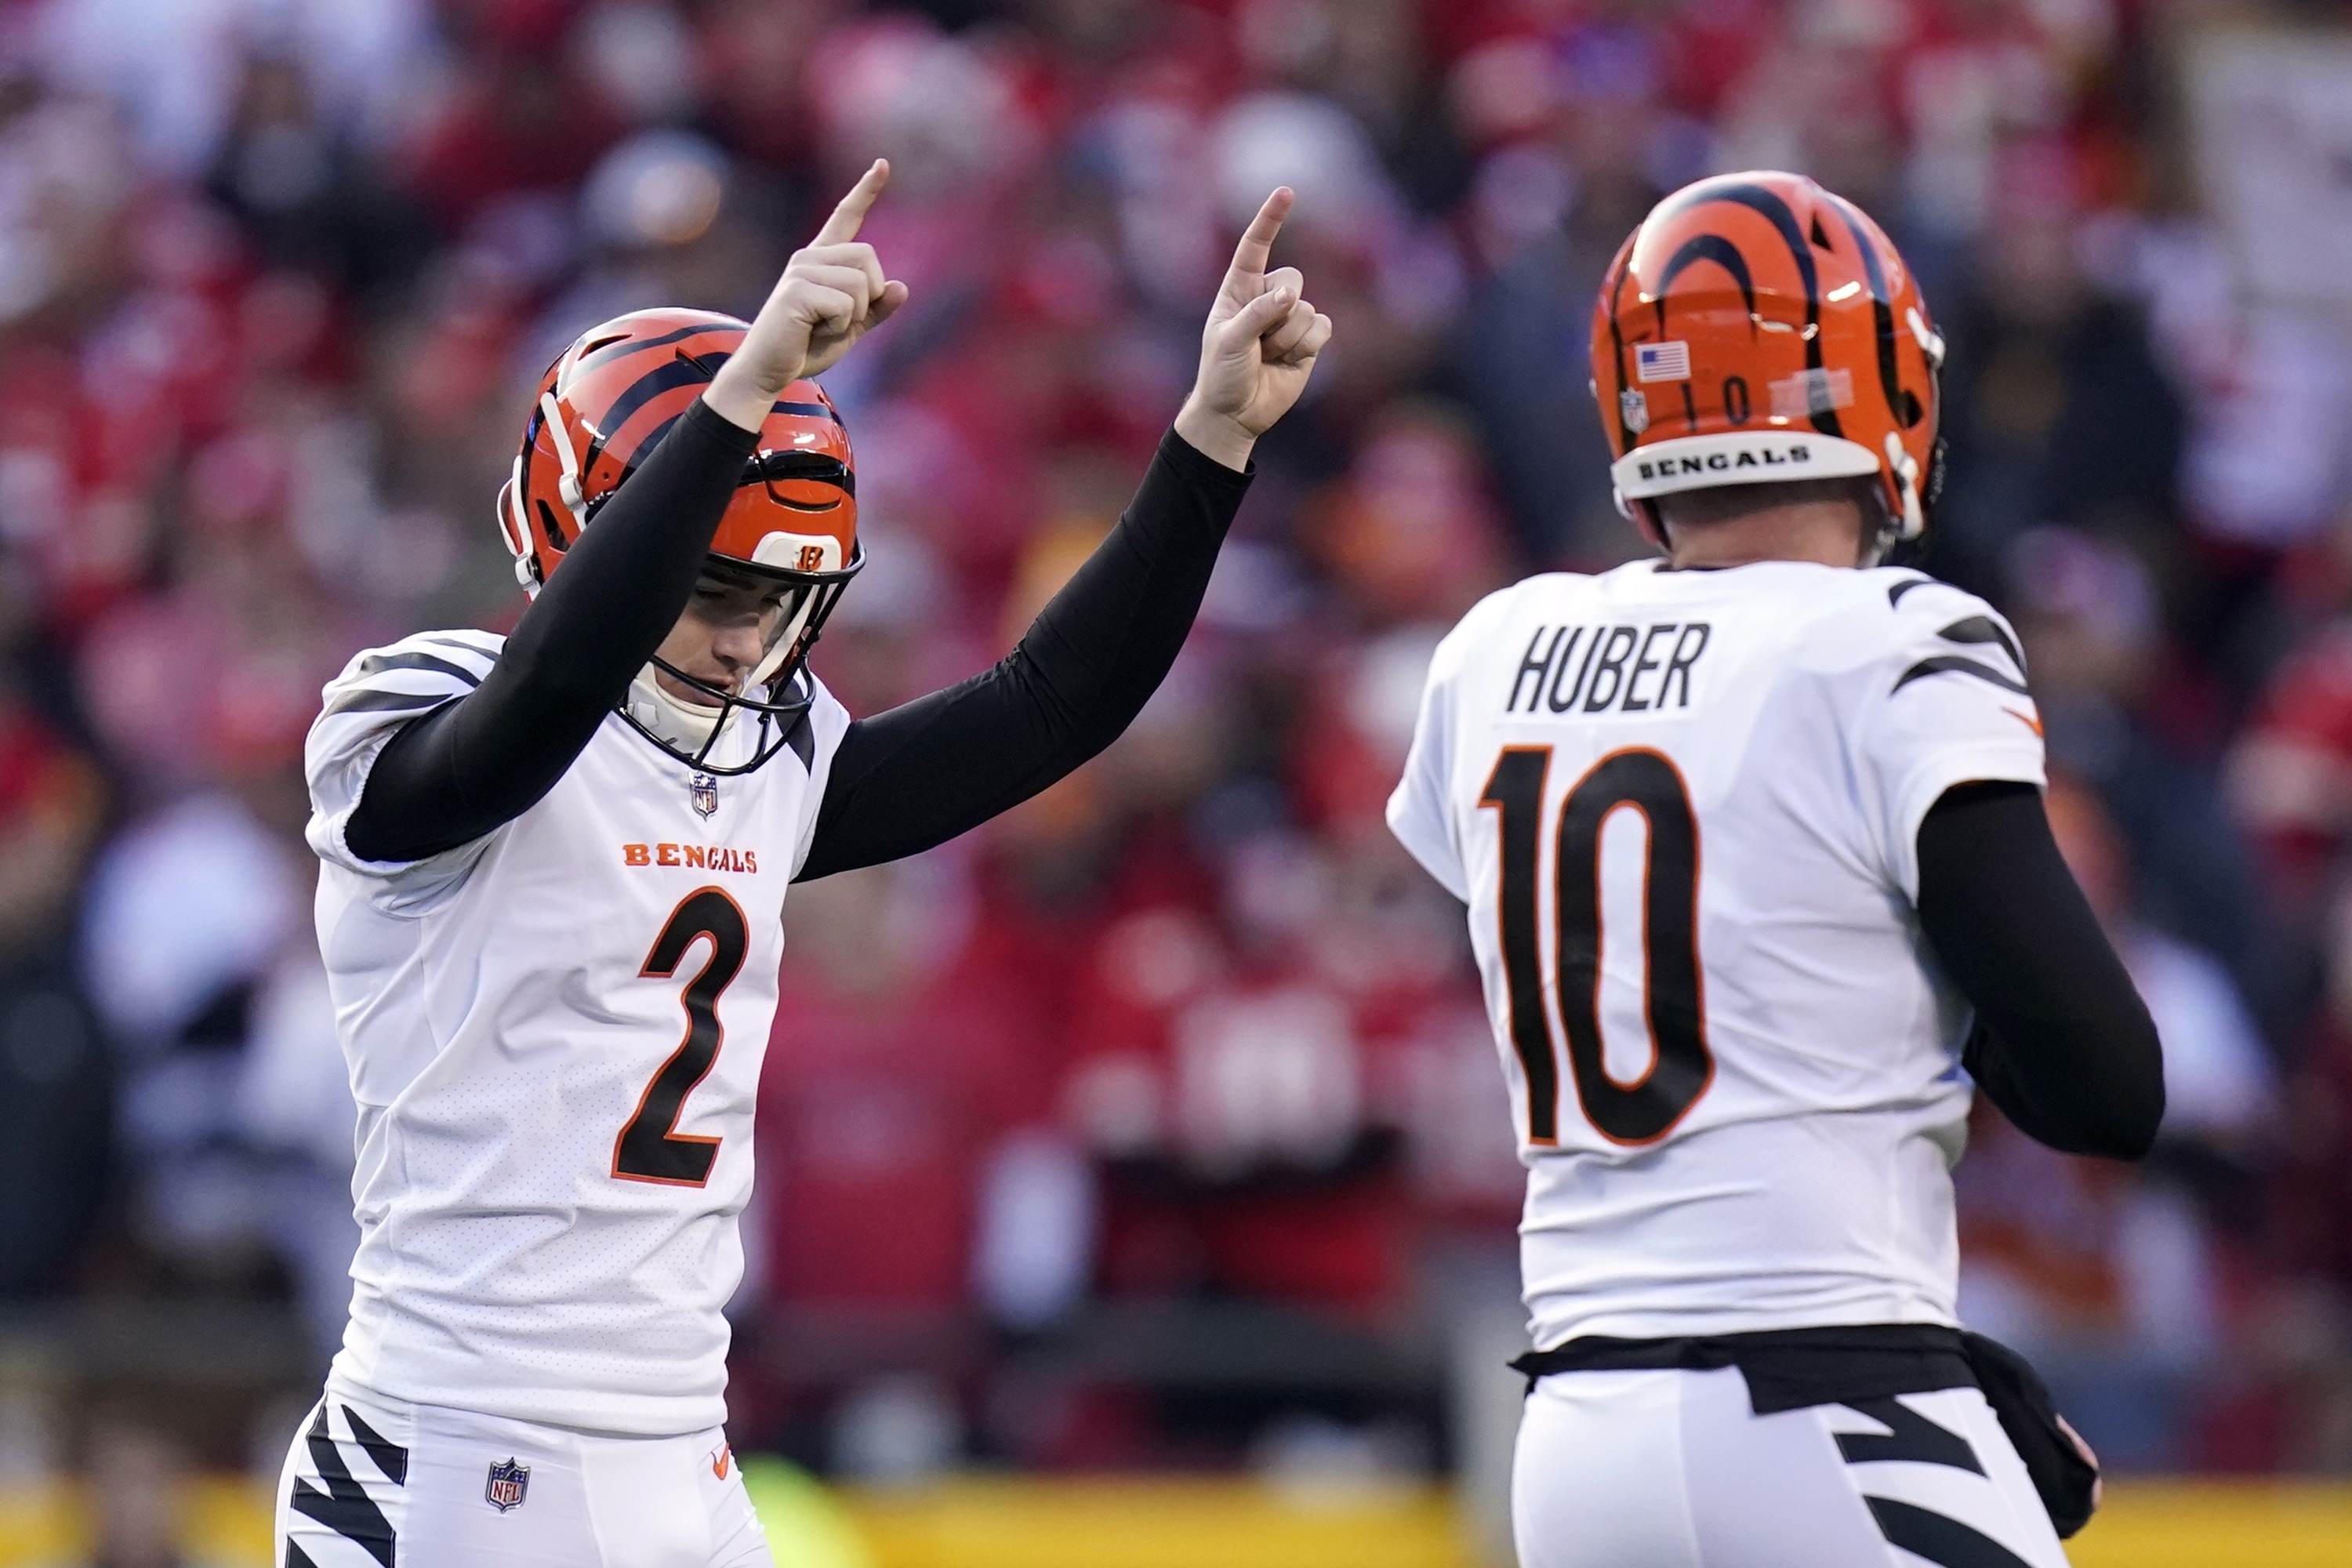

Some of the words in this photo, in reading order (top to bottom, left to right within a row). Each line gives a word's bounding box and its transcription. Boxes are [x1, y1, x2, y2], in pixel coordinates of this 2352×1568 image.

[1681, 376, 1751, 432] 10
[1639, 445, 1809, 480] BENGALS
[1506, 623, 1711, 713] HUBER
[696, 790, 715, 811] NFL
[622, 843, 757, 874] BENGALS
[1477, 744, 1715, 1146] 10
[611, 885, 750, 1189] 2
[492, 1481, 520, 1503] NFL
